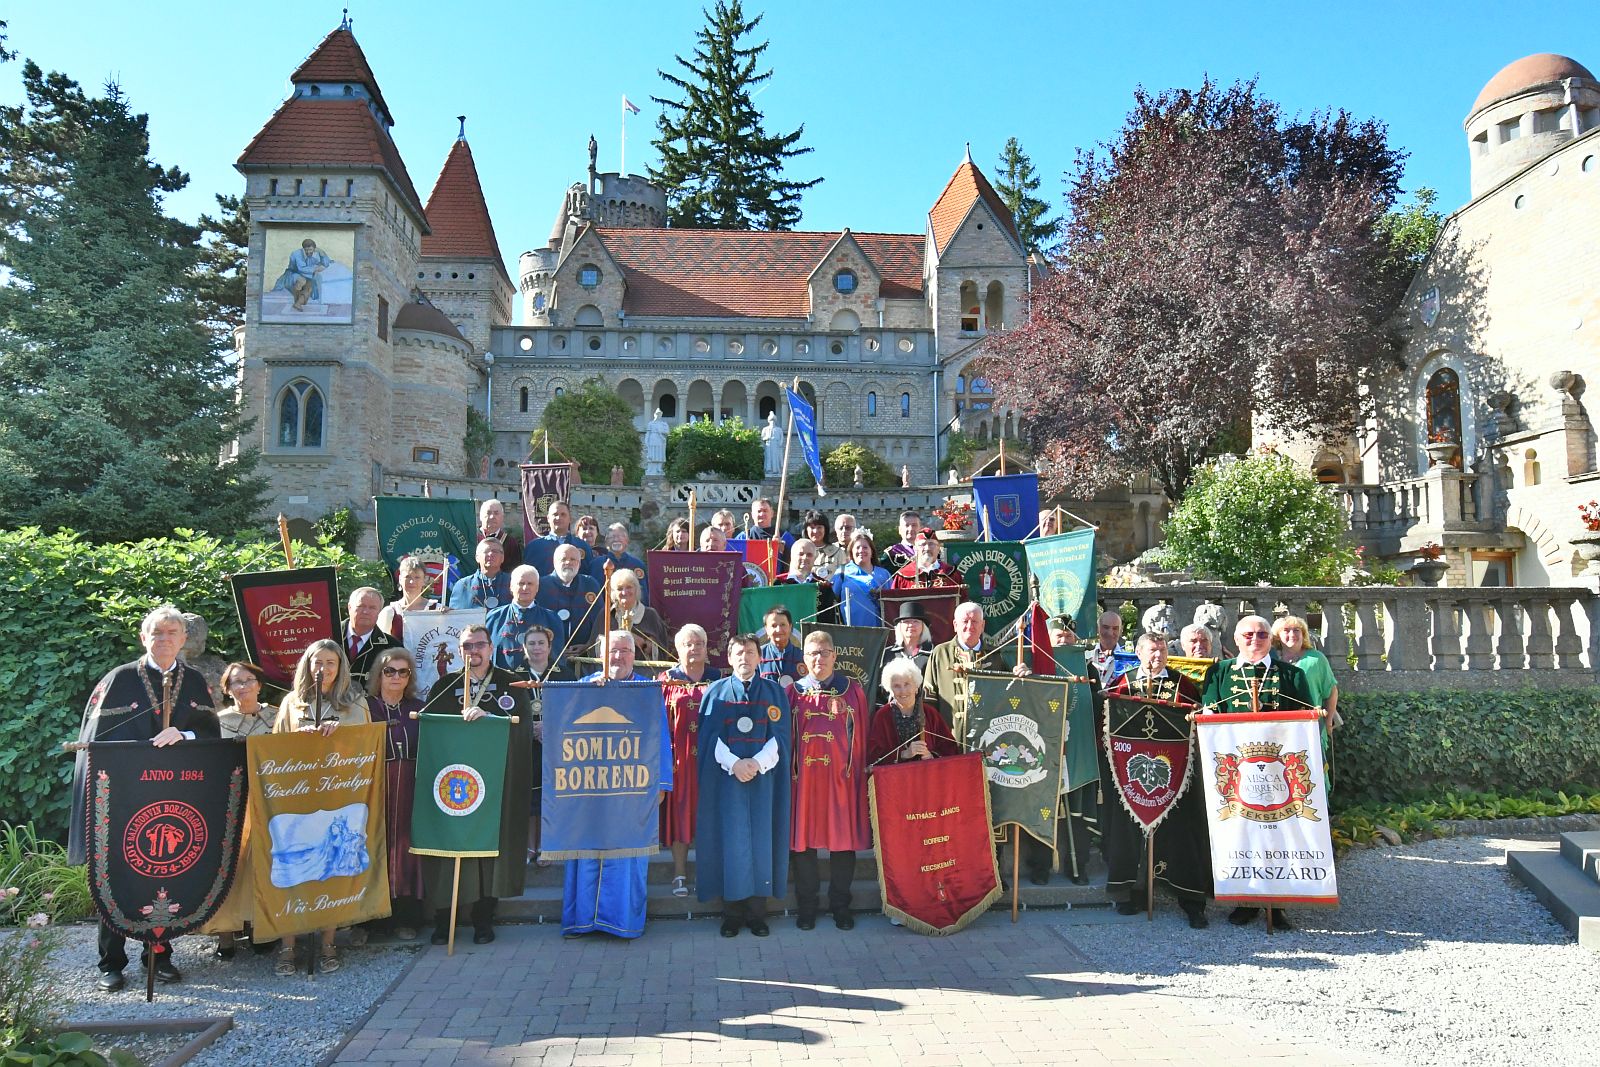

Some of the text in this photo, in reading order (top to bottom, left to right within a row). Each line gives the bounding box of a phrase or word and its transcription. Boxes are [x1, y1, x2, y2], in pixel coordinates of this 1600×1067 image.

[419, 530, 438, 538] 2009
[438, 518, 469, 555] BORREND
[663, 565, 705, 573] Velencei-tavi
[663, 576, 720, 586] Szent Benedictus
[663, 588, 707, 598] Borlovagrend
[265, 626, 316, 637] ZTERGOM
[834, 646, 865, 657] DAFOK
[562, 730, 641, 761] SOMLÓI
[1113, 741, 1132, 753] 2009
[256, 758, 320, 776] Balatoni
[140, 769, 204, 781] ANNO 1984
[554, 764, 650, 791] BORREND
[991, 771, 1033, 785] BADACSONY
[264, 772, 373, 799] Gizella Királyn
[1243, 783, 1287, 793] ORREND
[940, 806, 960, 817] JÁNOS
[127, 805, 161, 842] BALATONVIN
[923, 835, 950, 846] BORREND
[1228, 850, 1325, 860] LISCA BORREND
[920, 858, 956, 872] KECSKEMÉT
[1221, 863, 1327, 881] SZEKSZÁRD
[275, 886, 367, 918] Női Borrend
